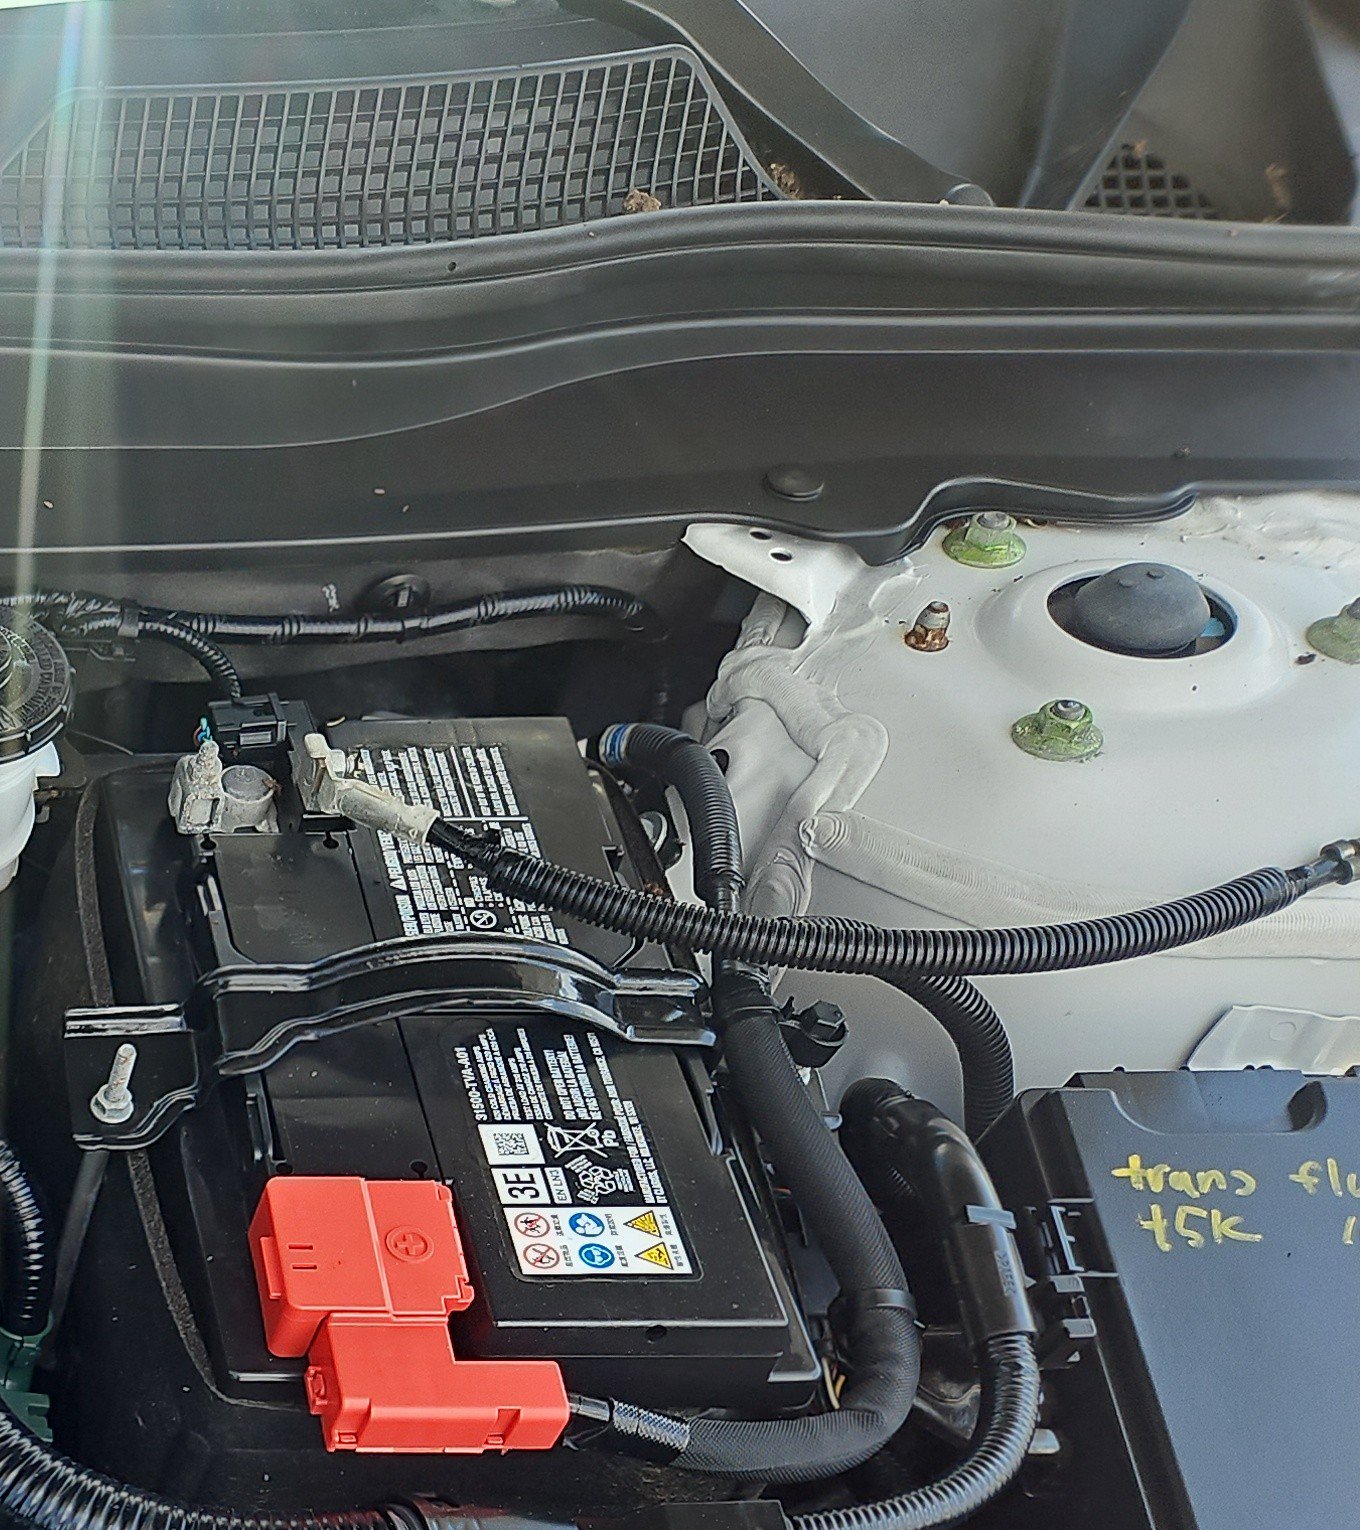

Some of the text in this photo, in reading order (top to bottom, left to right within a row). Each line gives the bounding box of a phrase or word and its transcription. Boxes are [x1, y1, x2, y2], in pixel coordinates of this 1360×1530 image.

[454, 1046, 488, 1120] 31500-TVA-A01
[598, 1129, 620, 1146] Pb
[501, 1172, 541, 1199] 3E
